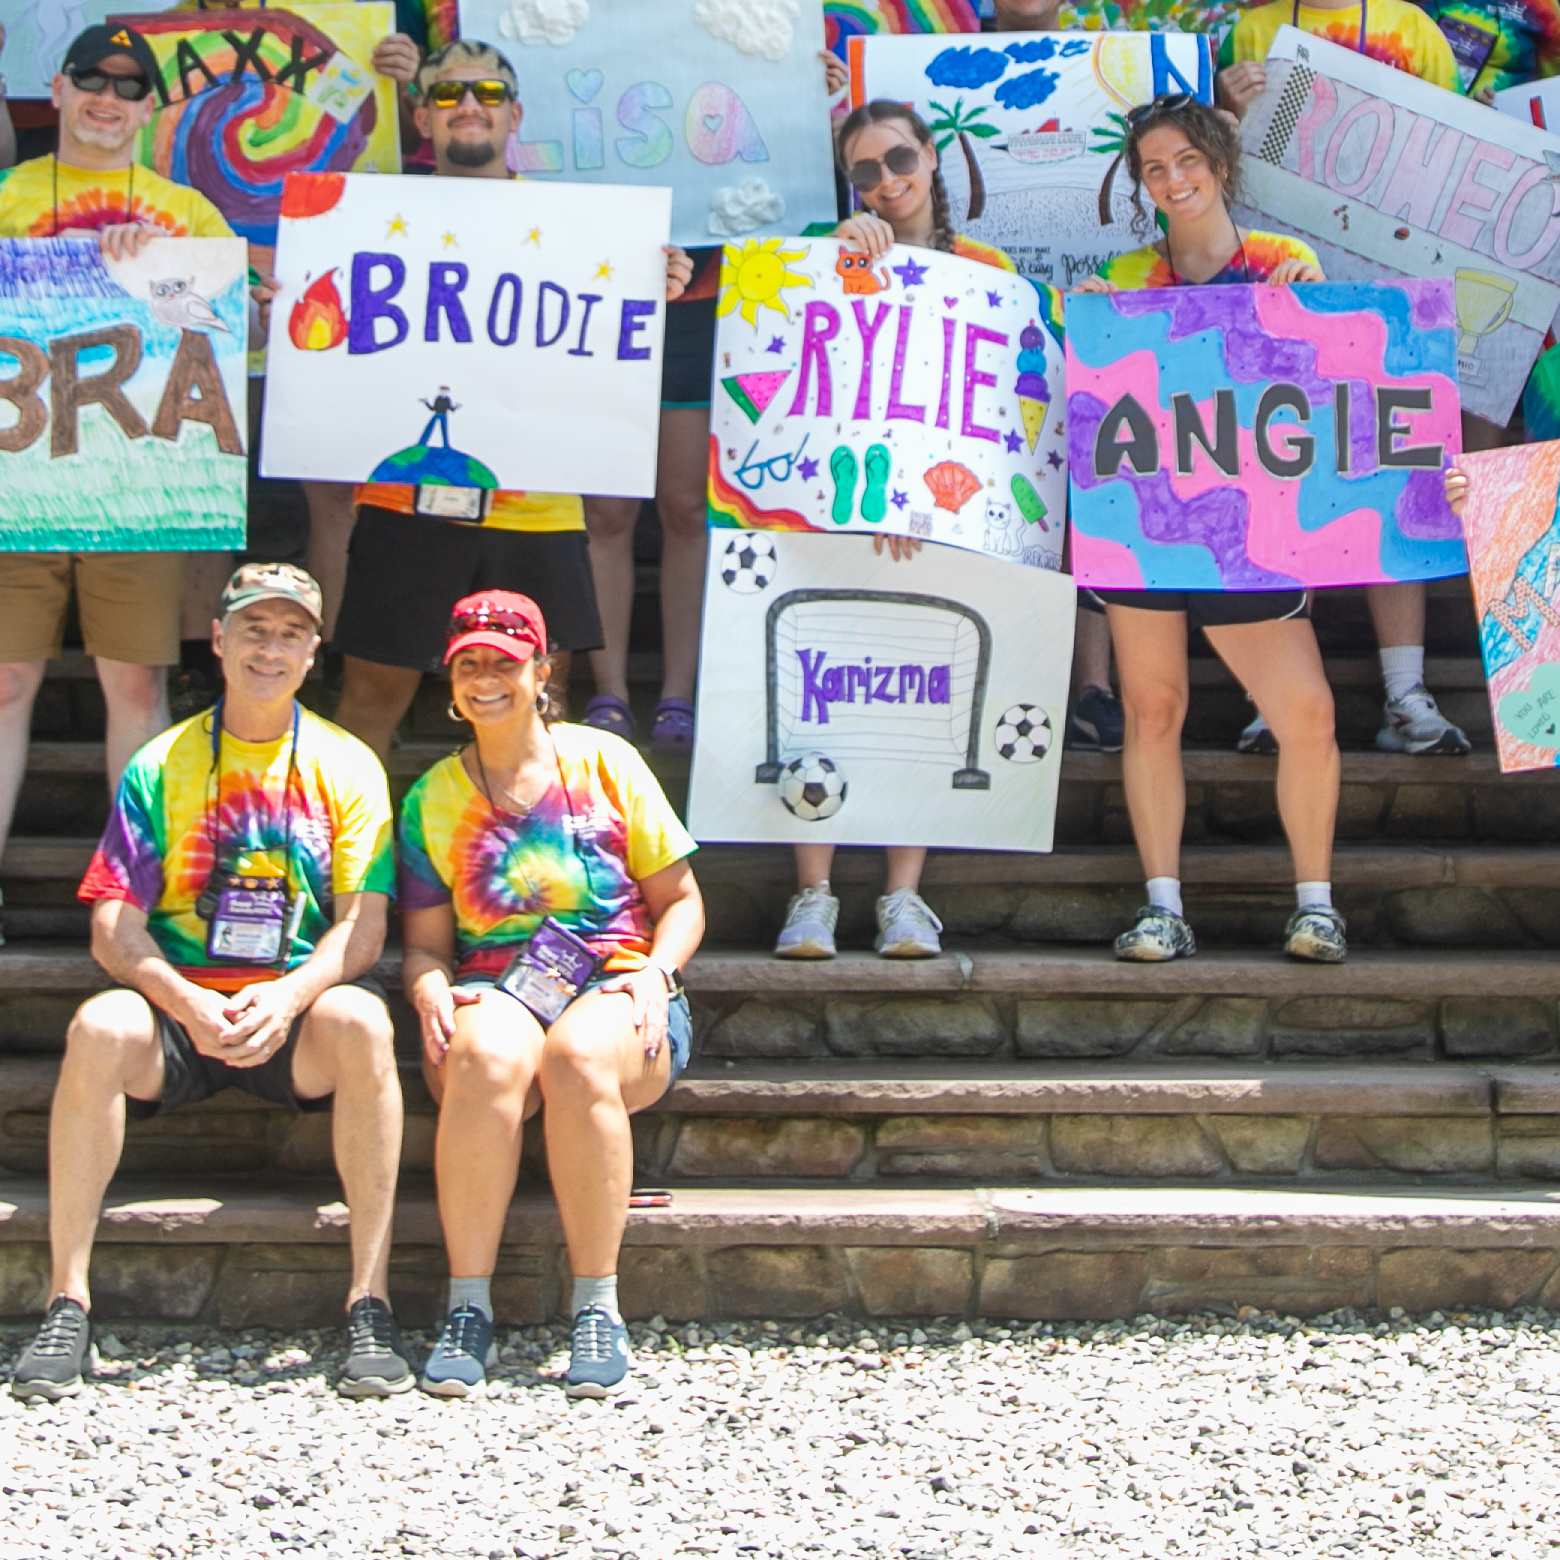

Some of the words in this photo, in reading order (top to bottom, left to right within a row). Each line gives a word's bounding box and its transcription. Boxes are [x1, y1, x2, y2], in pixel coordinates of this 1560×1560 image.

[347, 251, 658, 361] BRODIE
[785, 298, 1010, 445] RYLIE
[1093, 381, 1446, 480] ANGIE
[795, 646, 952, 725] Karizma
[1515, 702, 1533, 720] YOU
[1537, 688, 1557, 709] ARE
